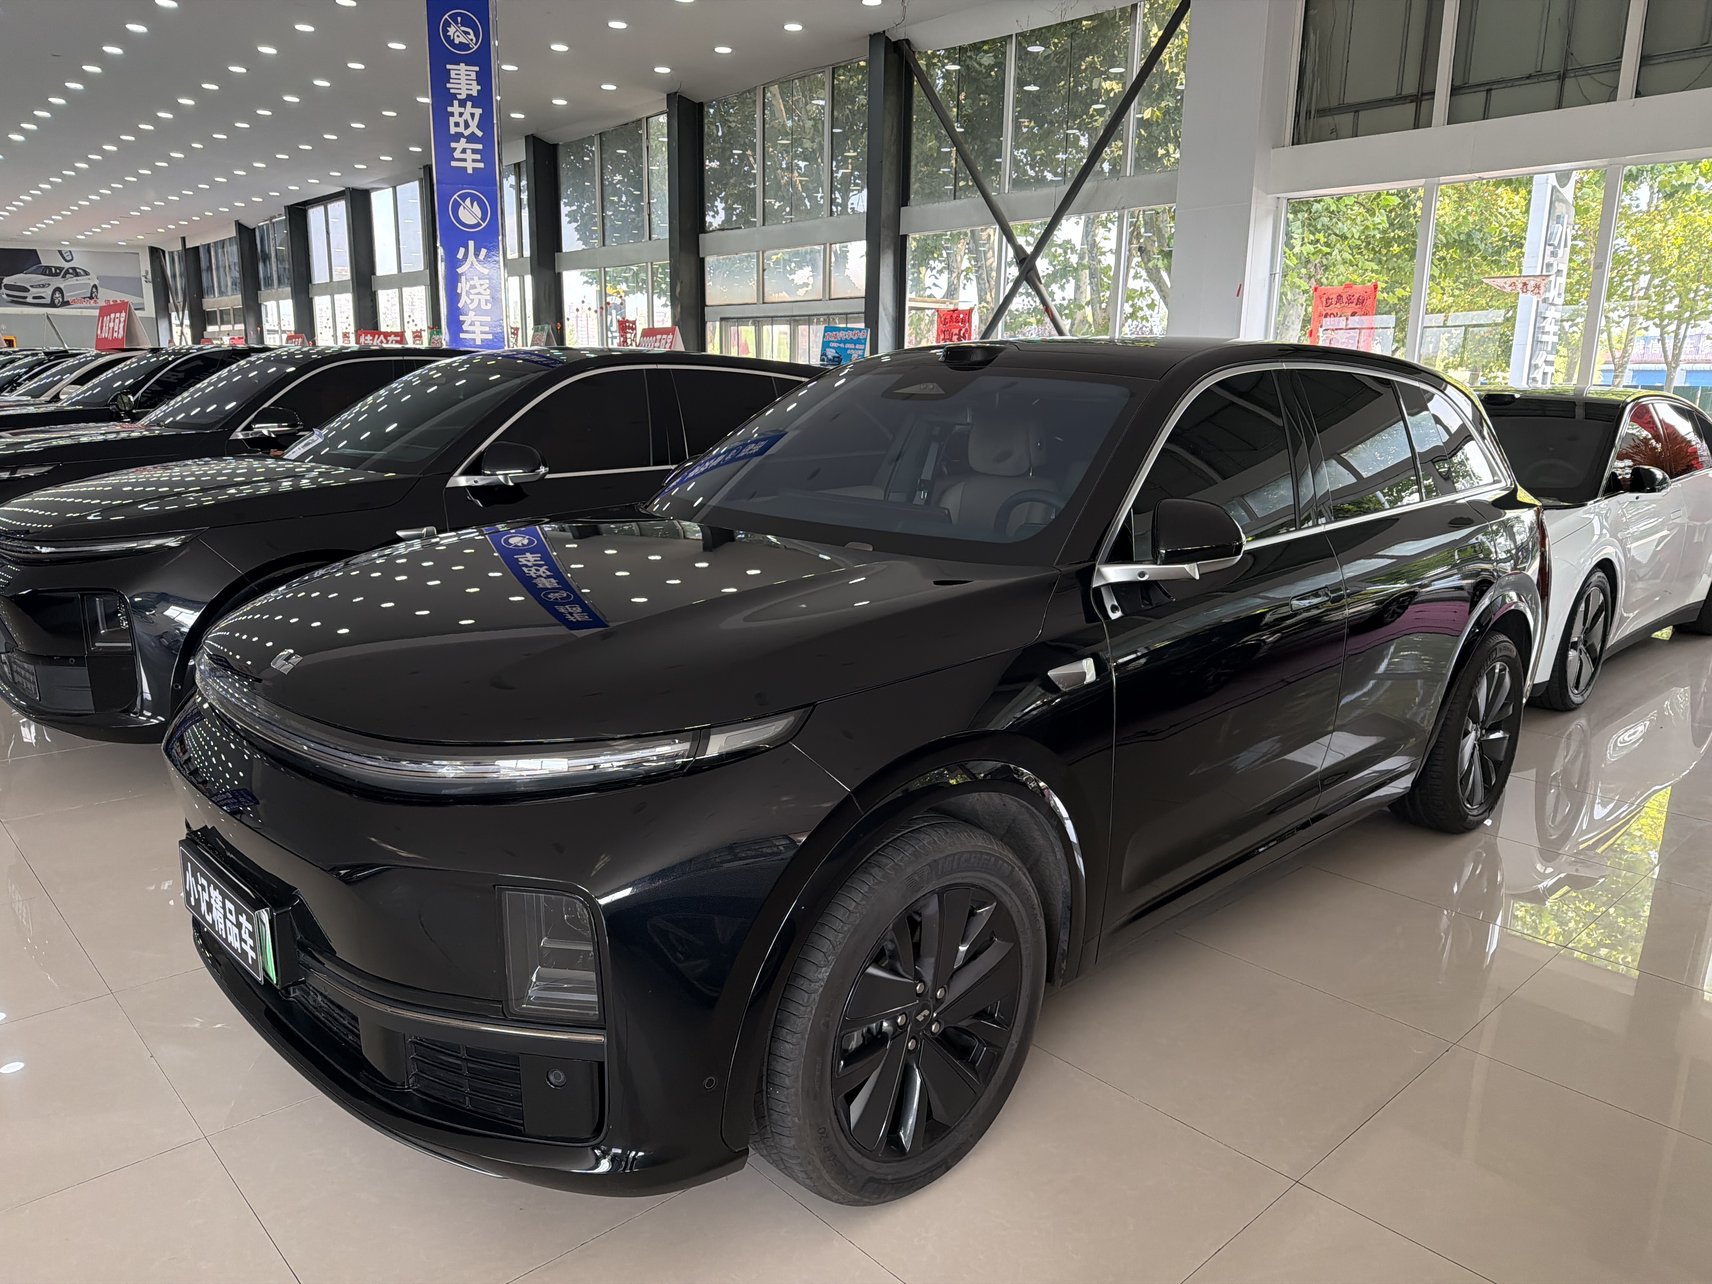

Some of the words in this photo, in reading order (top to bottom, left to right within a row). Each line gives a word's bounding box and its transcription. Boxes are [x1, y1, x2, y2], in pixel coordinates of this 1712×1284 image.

[445, 62, 485, 174] 事故车
[455, 240, 493, 345] 火烧车
[185, 862, 256, 965] 小记精品车
